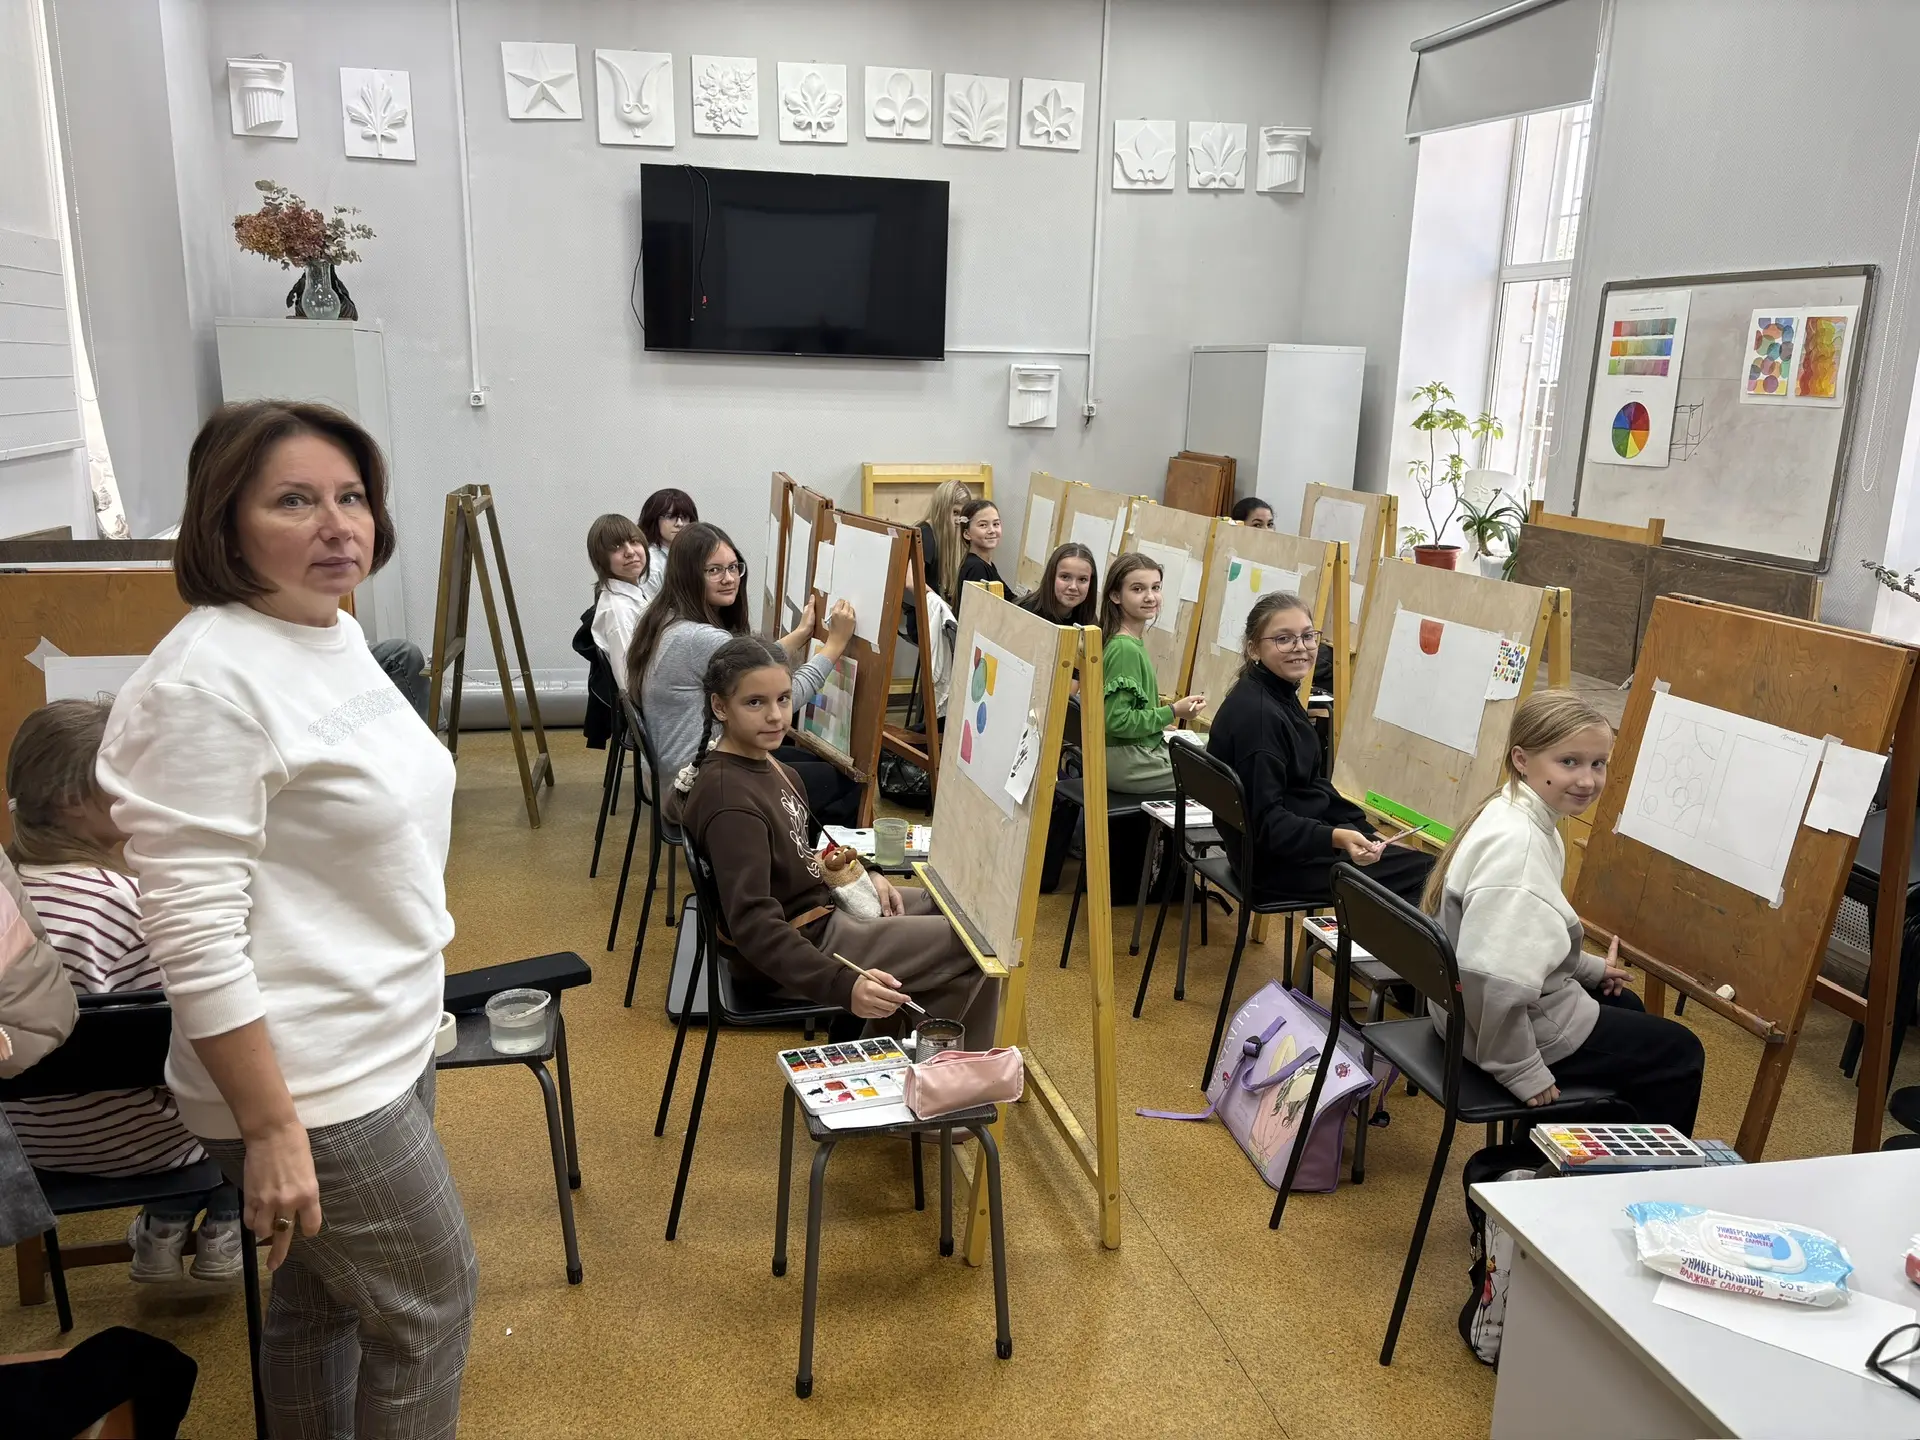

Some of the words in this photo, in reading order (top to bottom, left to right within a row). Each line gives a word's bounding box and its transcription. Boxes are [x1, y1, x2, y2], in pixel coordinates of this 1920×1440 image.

[1716, 1225, 1771, 1241] УНИВЕРСАЛЬНЫЕ
[1679, 1266, 1718, 1286] ВЛАЖНЫЕ
[1720, 1281, 1764, 1297] САЛФЕТКИ
[1681, 1257, 1764, 1288] УНИВЕРСАЛЬНЫЕ
